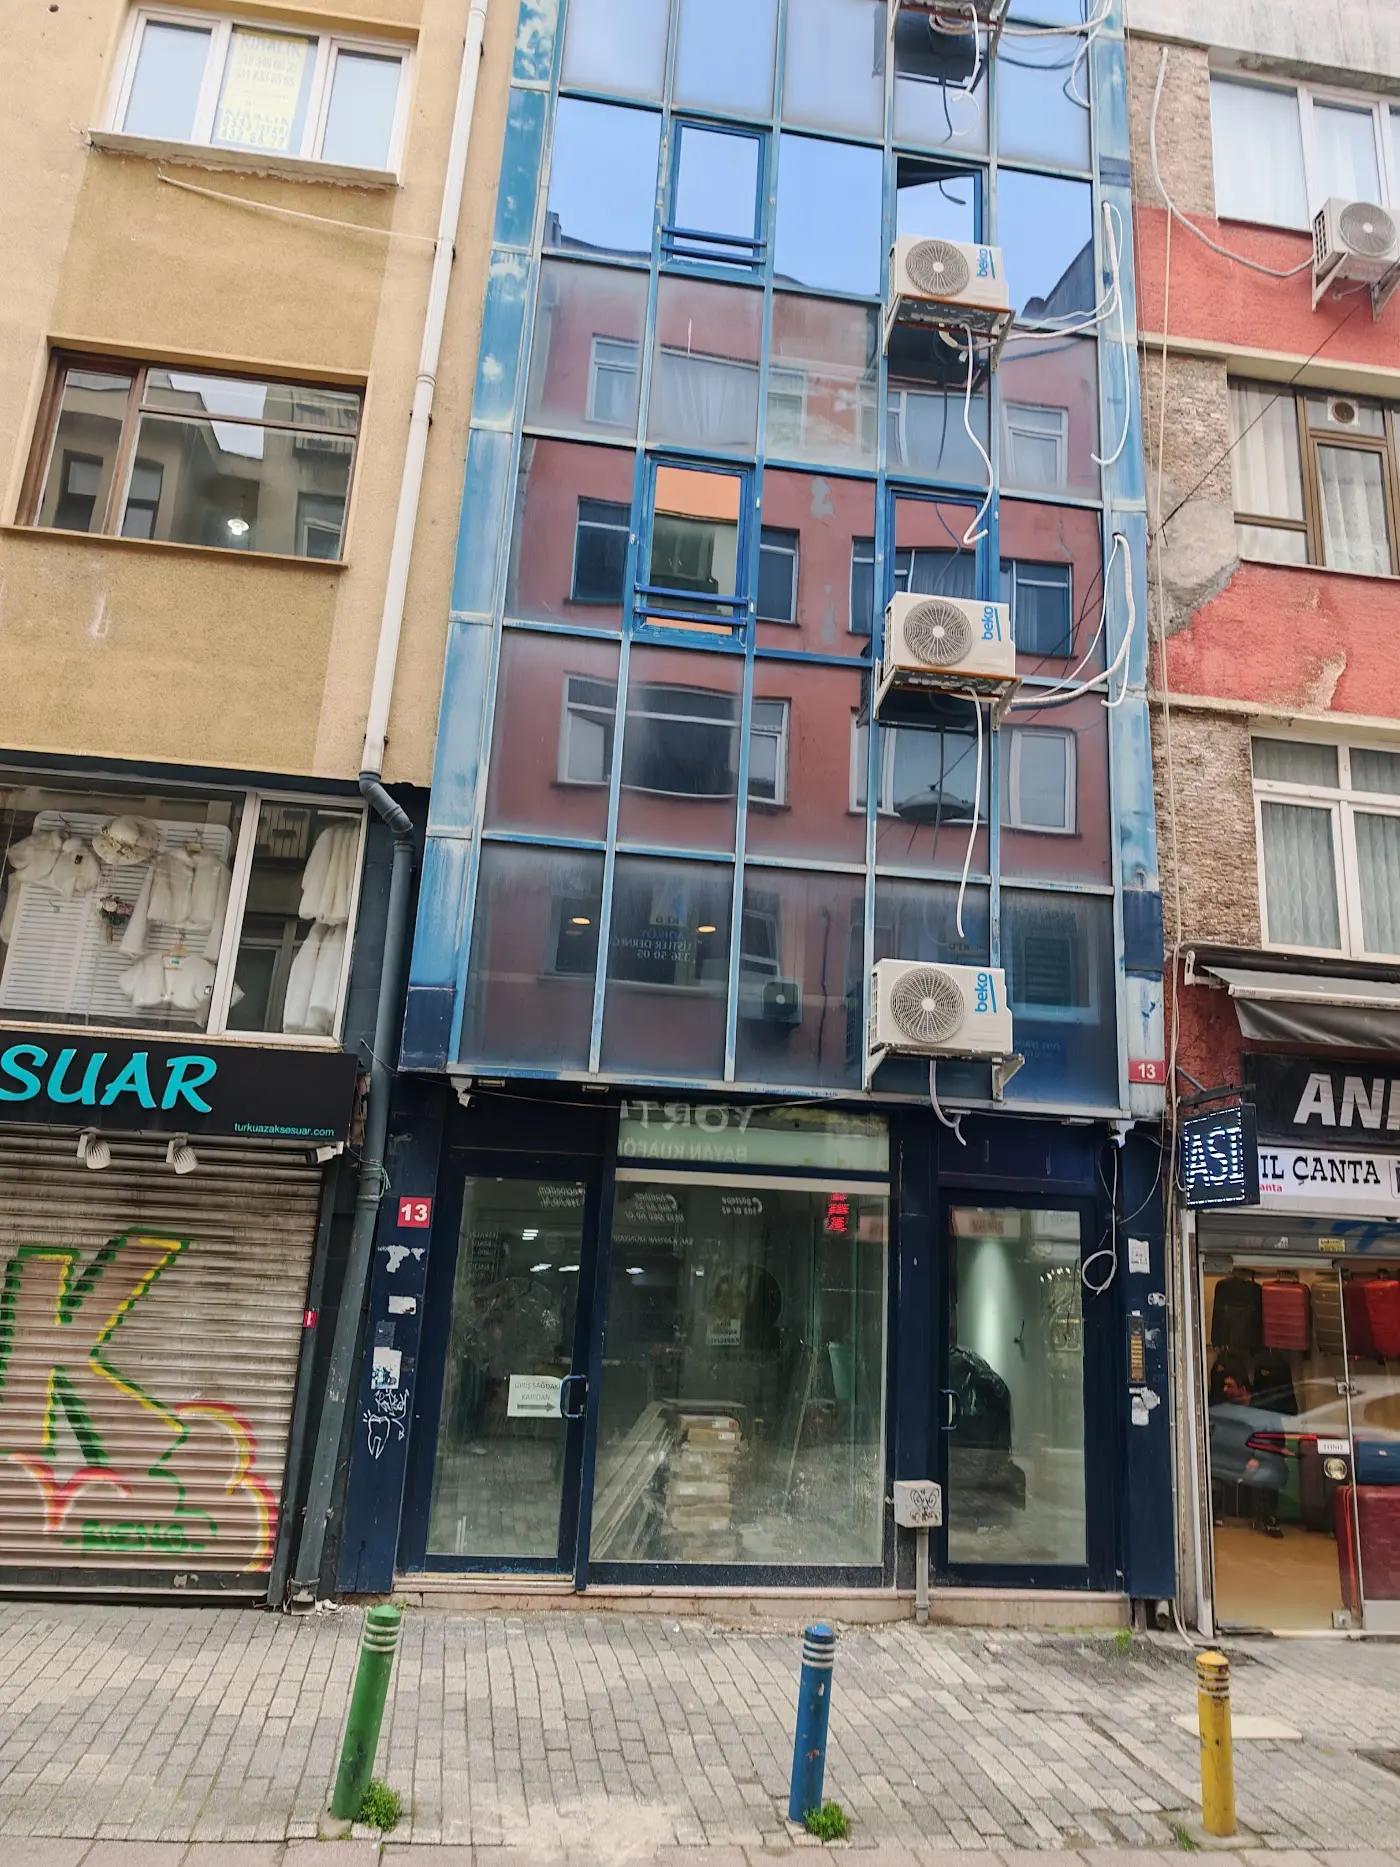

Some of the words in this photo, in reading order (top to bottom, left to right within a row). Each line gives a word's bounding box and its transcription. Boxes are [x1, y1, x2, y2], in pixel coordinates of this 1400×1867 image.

[977, 248, 988, 277] beko
[981, 606, 994, 640] beko
[974, 973, 988, 1012] beko
[0, 1044, 217, 1113] SUAR
[1138, 1063, 1156, 1079] 13
[234, 1123, 335, 1137] turkuazaksesuar.com
[1292, 1156, 1381, 1186] ÇANTA
[401, 1203, 428, 1222] 13
